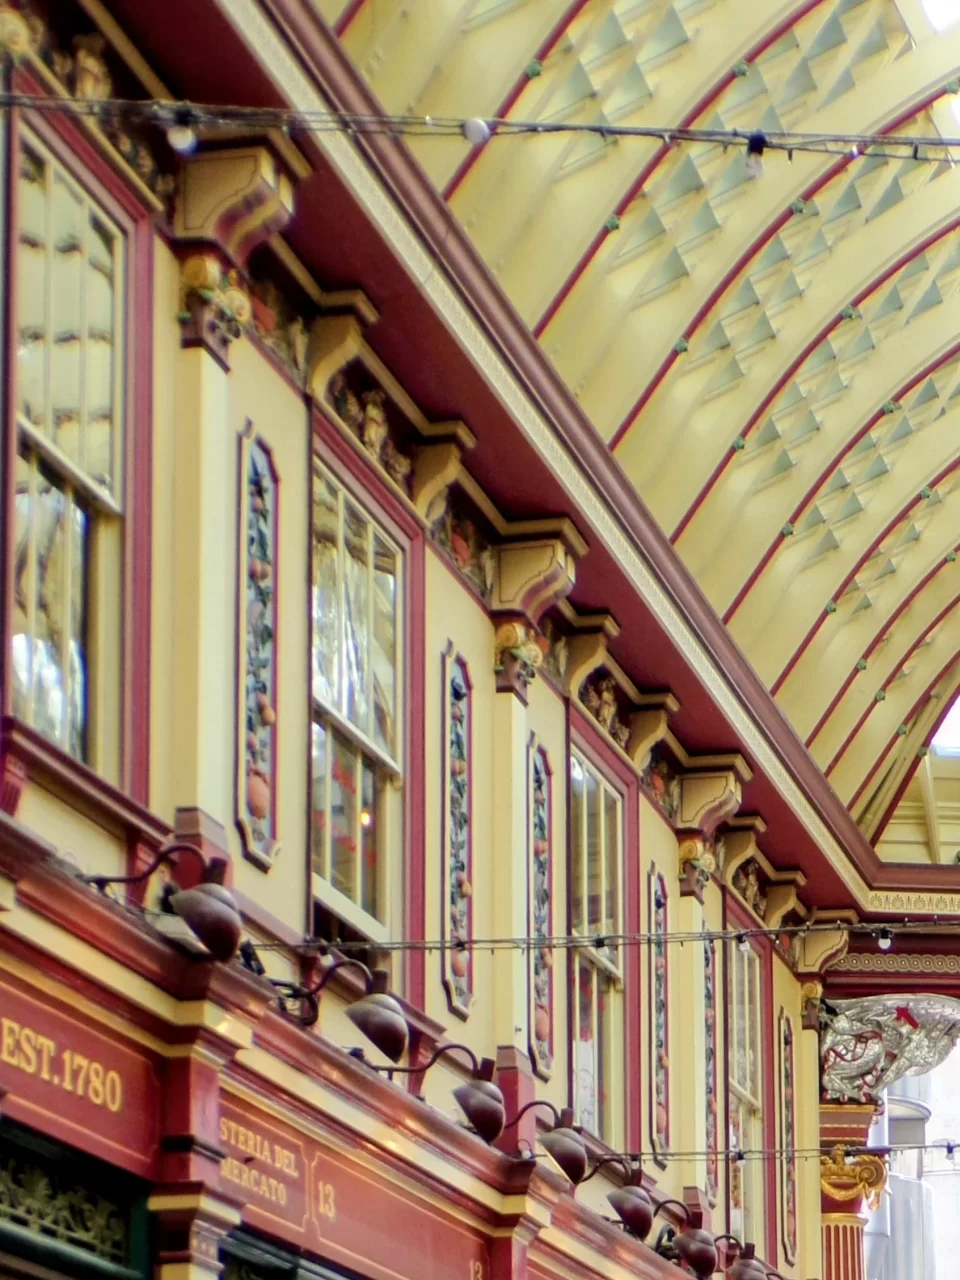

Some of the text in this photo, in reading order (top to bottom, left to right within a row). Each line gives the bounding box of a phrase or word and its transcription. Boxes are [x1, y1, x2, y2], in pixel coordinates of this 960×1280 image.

[1, 1017, 122, 1112] EST.1780
[221, 1157, 288, 1207] MERCATO
[275, 1144, 299, 1178] DEL
[318, 1181, 336, 1219] 13
